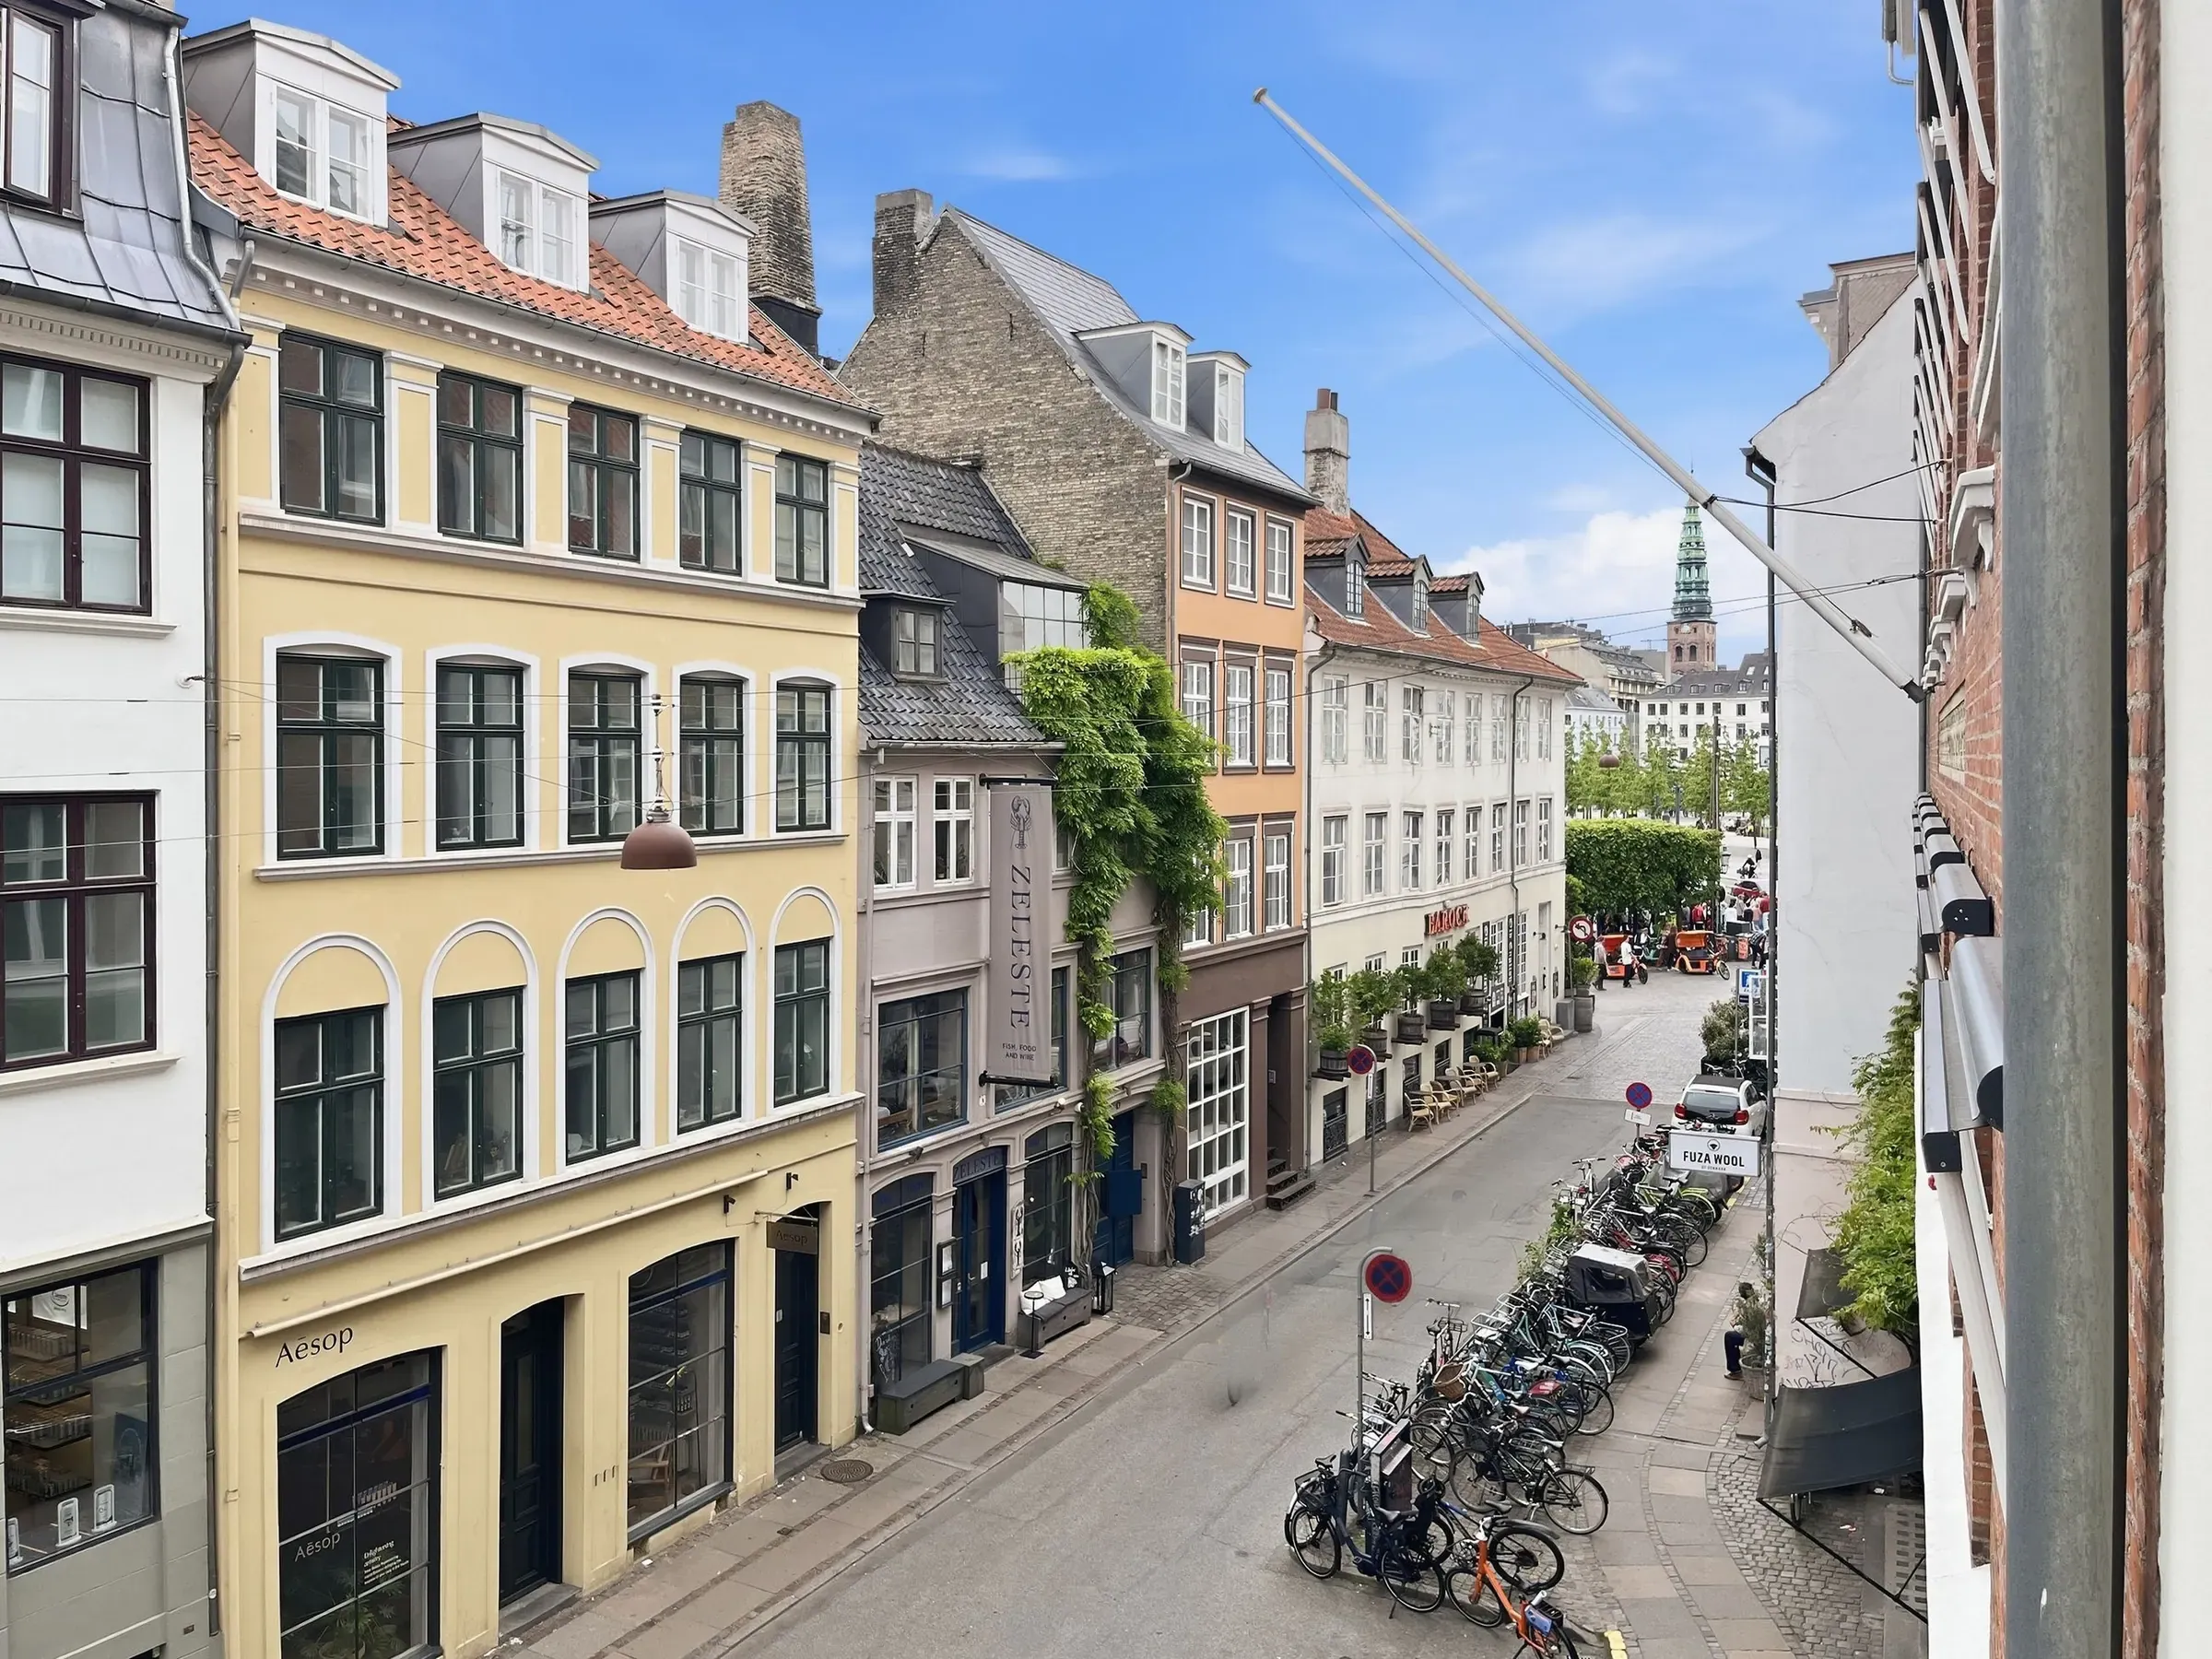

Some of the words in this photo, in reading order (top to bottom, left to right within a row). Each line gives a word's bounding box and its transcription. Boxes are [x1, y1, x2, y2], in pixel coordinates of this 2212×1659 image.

[1010, 865, 1031, 1029] ZELESTE
[953, 1154, 1001, 1182] ZELESTE
[1683, 1150, 1712, 1164] FUZA
[1713, 1154, 1745, 1167] WOOL
[276, 1327, 353, 1368] Aēsop
